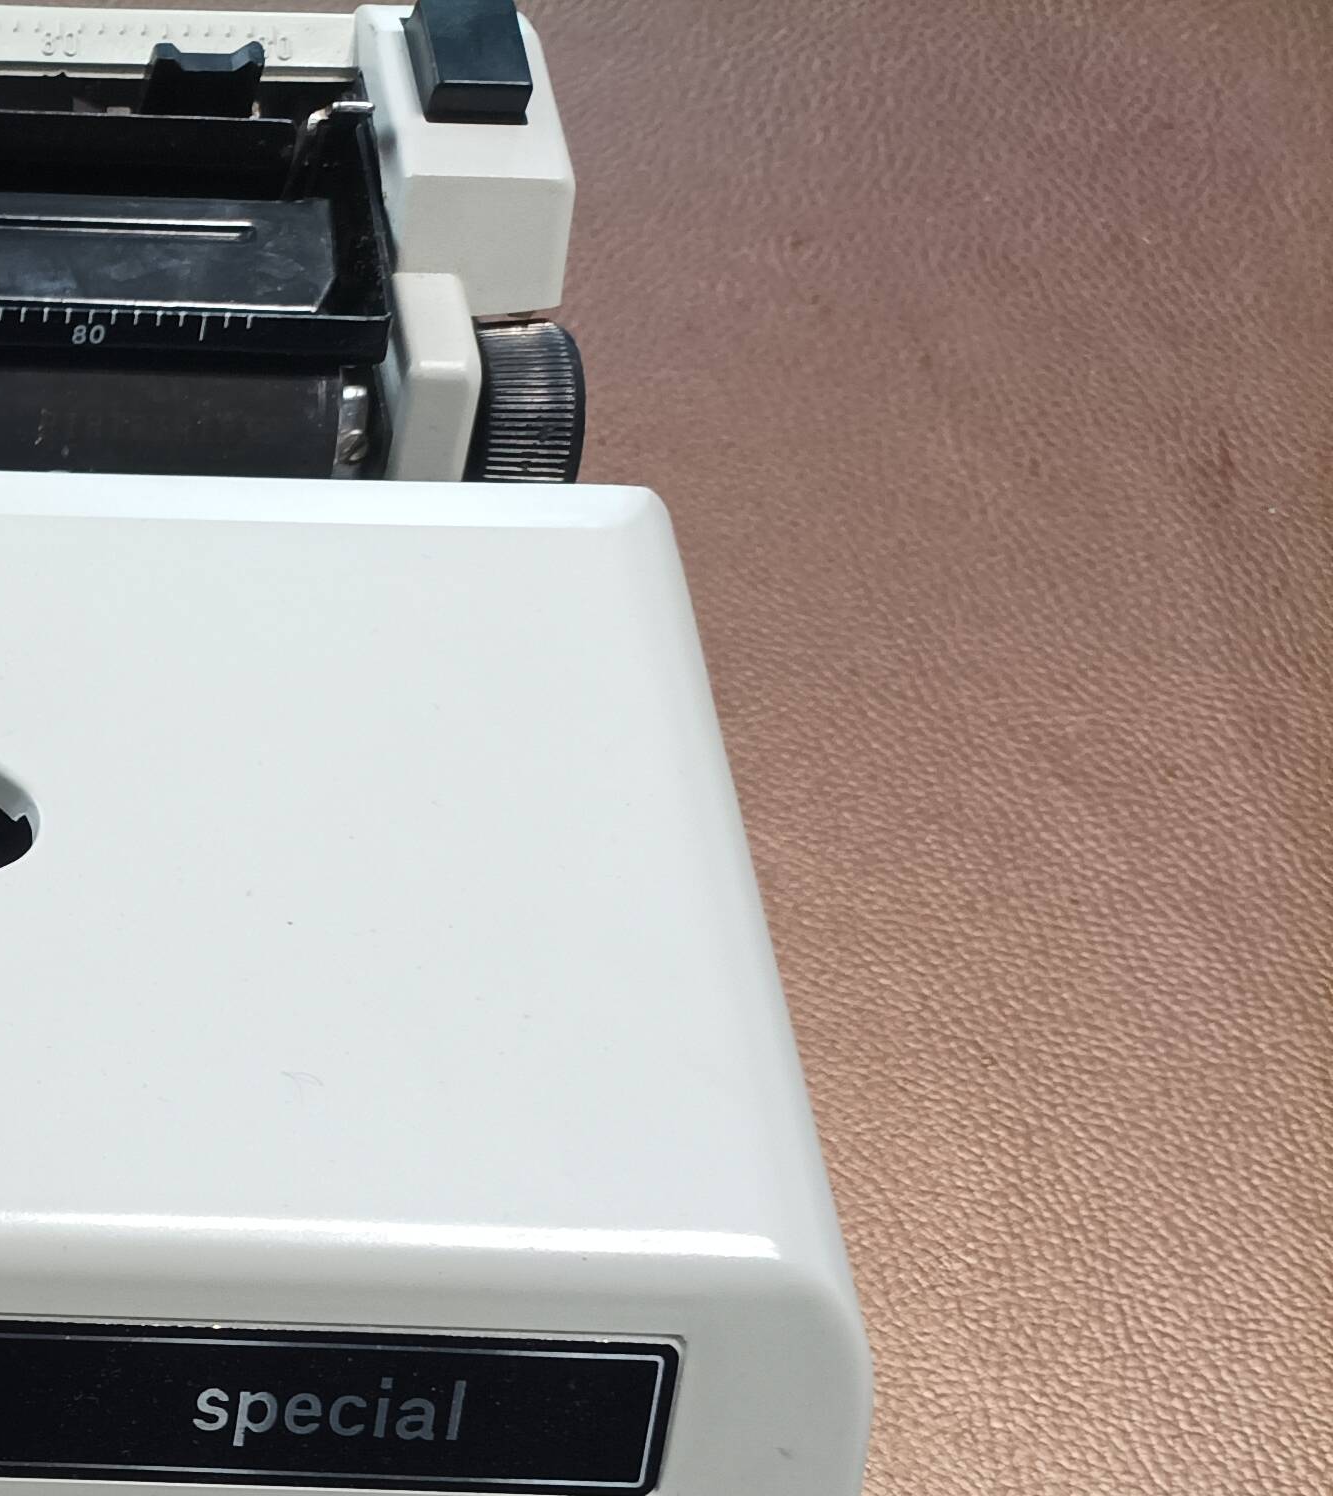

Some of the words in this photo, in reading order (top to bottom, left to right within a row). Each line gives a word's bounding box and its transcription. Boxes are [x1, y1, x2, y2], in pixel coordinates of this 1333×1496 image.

[41, 32, 77, 57] 80
[71, 321, 106, 345] 80
[192, 1377, 467, 1447] special
